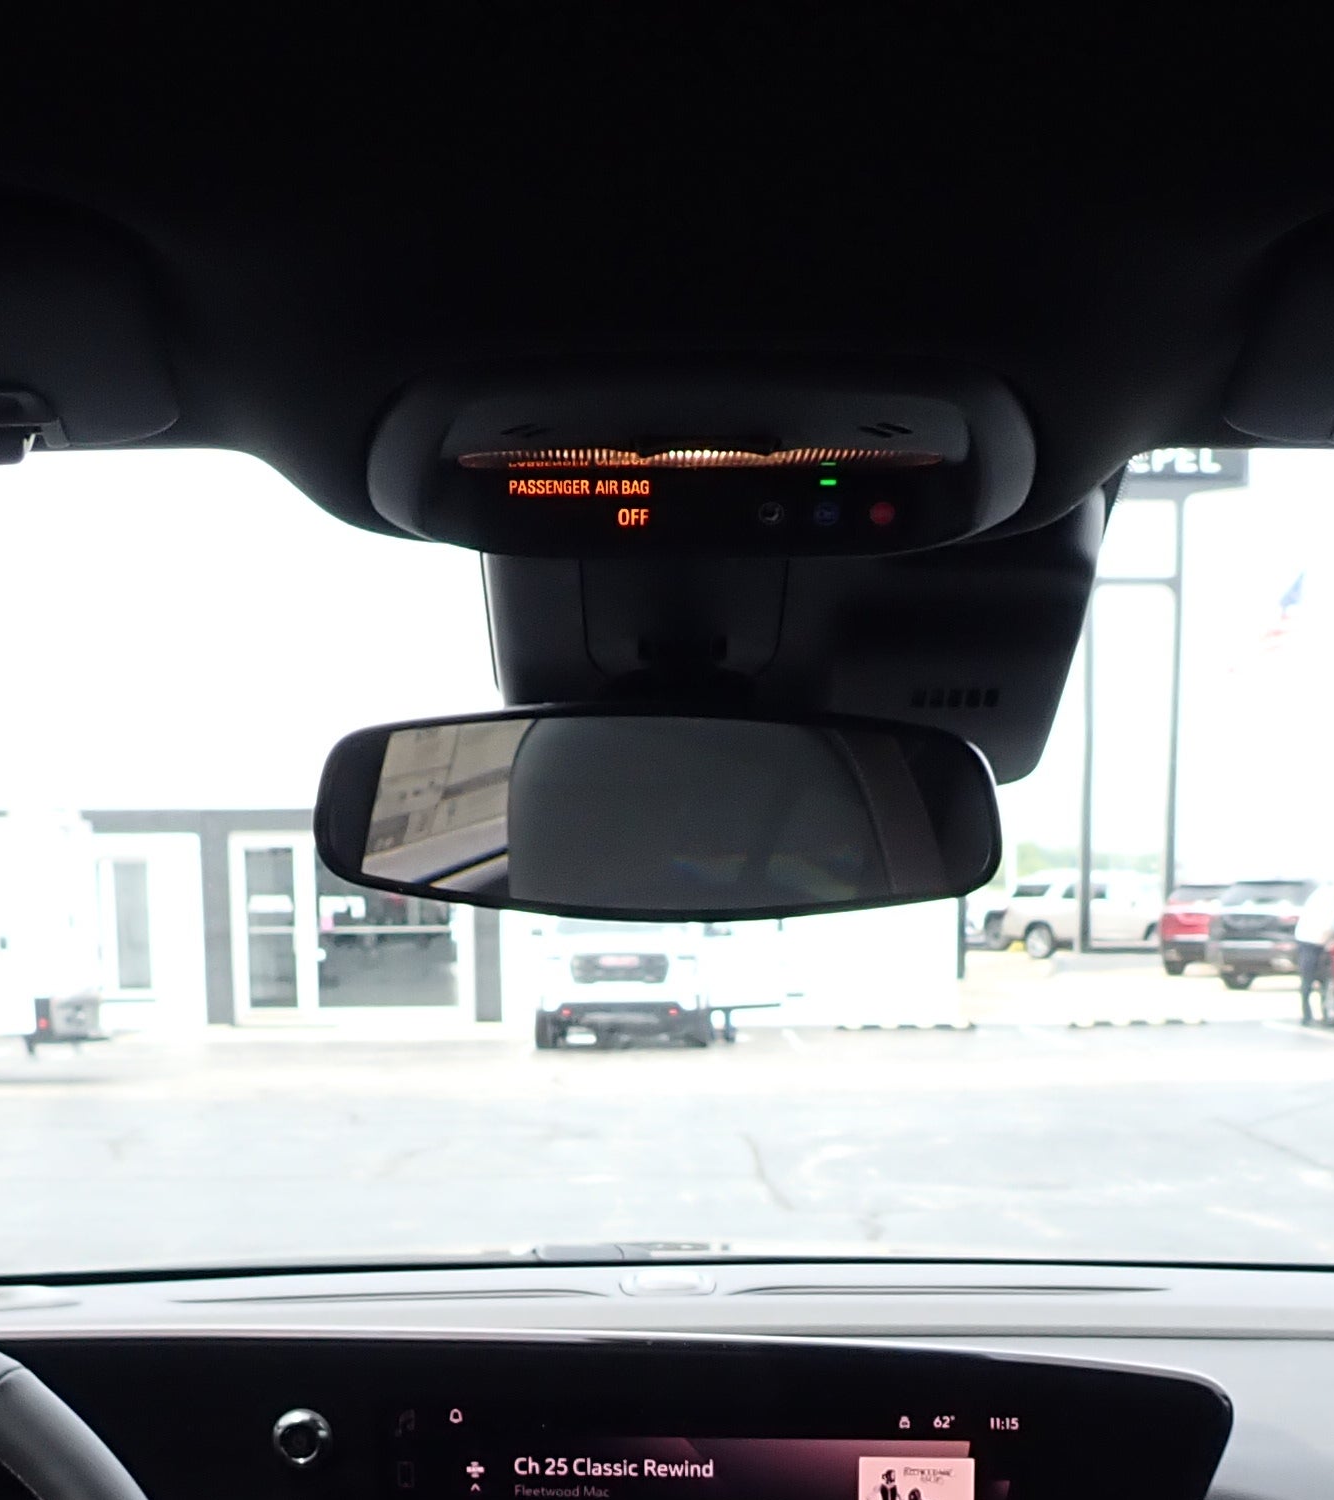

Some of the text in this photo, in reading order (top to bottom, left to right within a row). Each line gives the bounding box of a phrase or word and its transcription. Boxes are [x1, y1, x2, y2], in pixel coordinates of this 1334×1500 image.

[509, 480, 650, 496] PASSENGER AIR BAG
[617, 508, 650, 527] OFF
[989, 1416, 1020, 1431] 11:15
[513, 1456, 715, 1478] Ch 25 Classic Rewind
[513, 1484, 611, 1498] Fleetwood Mac
